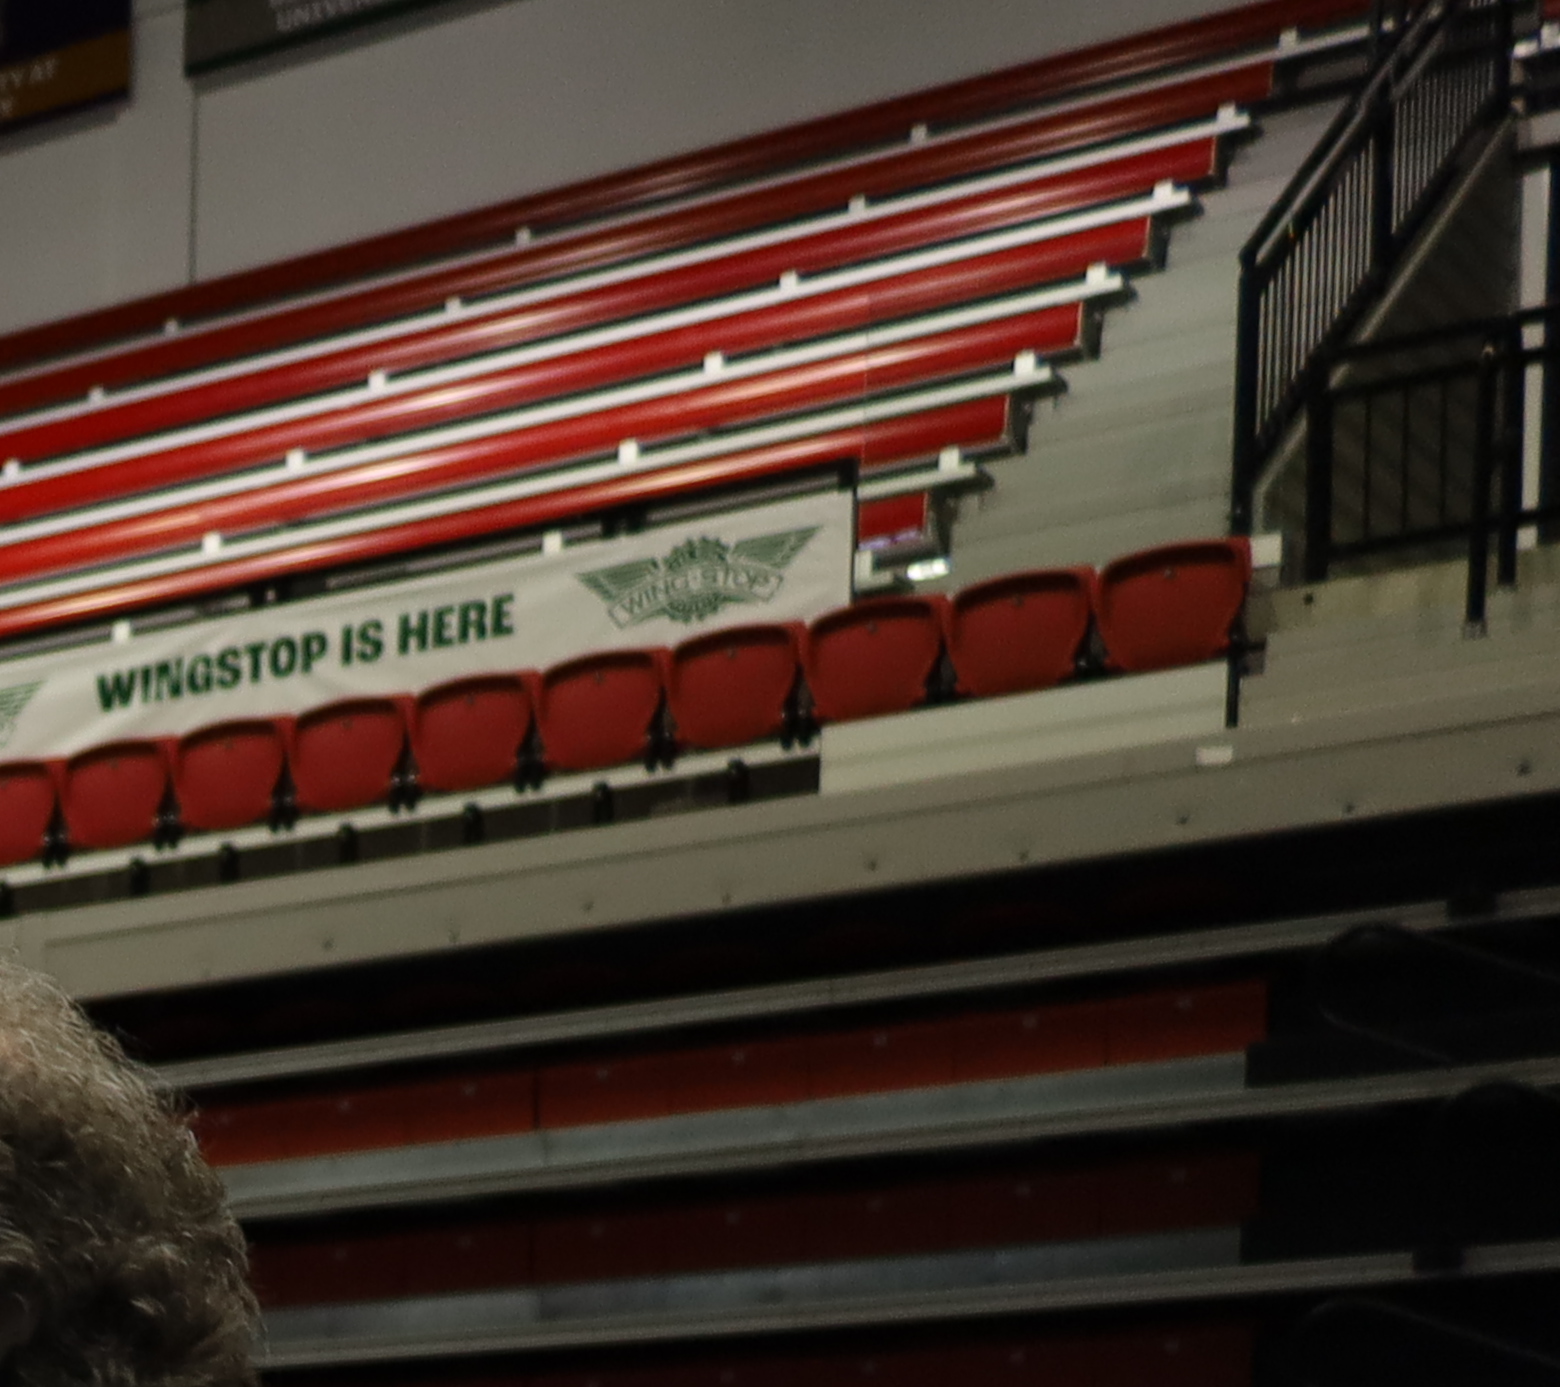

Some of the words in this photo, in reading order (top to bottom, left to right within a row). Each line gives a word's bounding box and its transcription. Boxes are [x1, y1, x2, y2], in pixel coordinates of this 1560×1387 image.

[97, 633, 325, 712] WINGSTOP
[341, 620, 384, 665] IS
[398, 594, 514, 655] HERE
